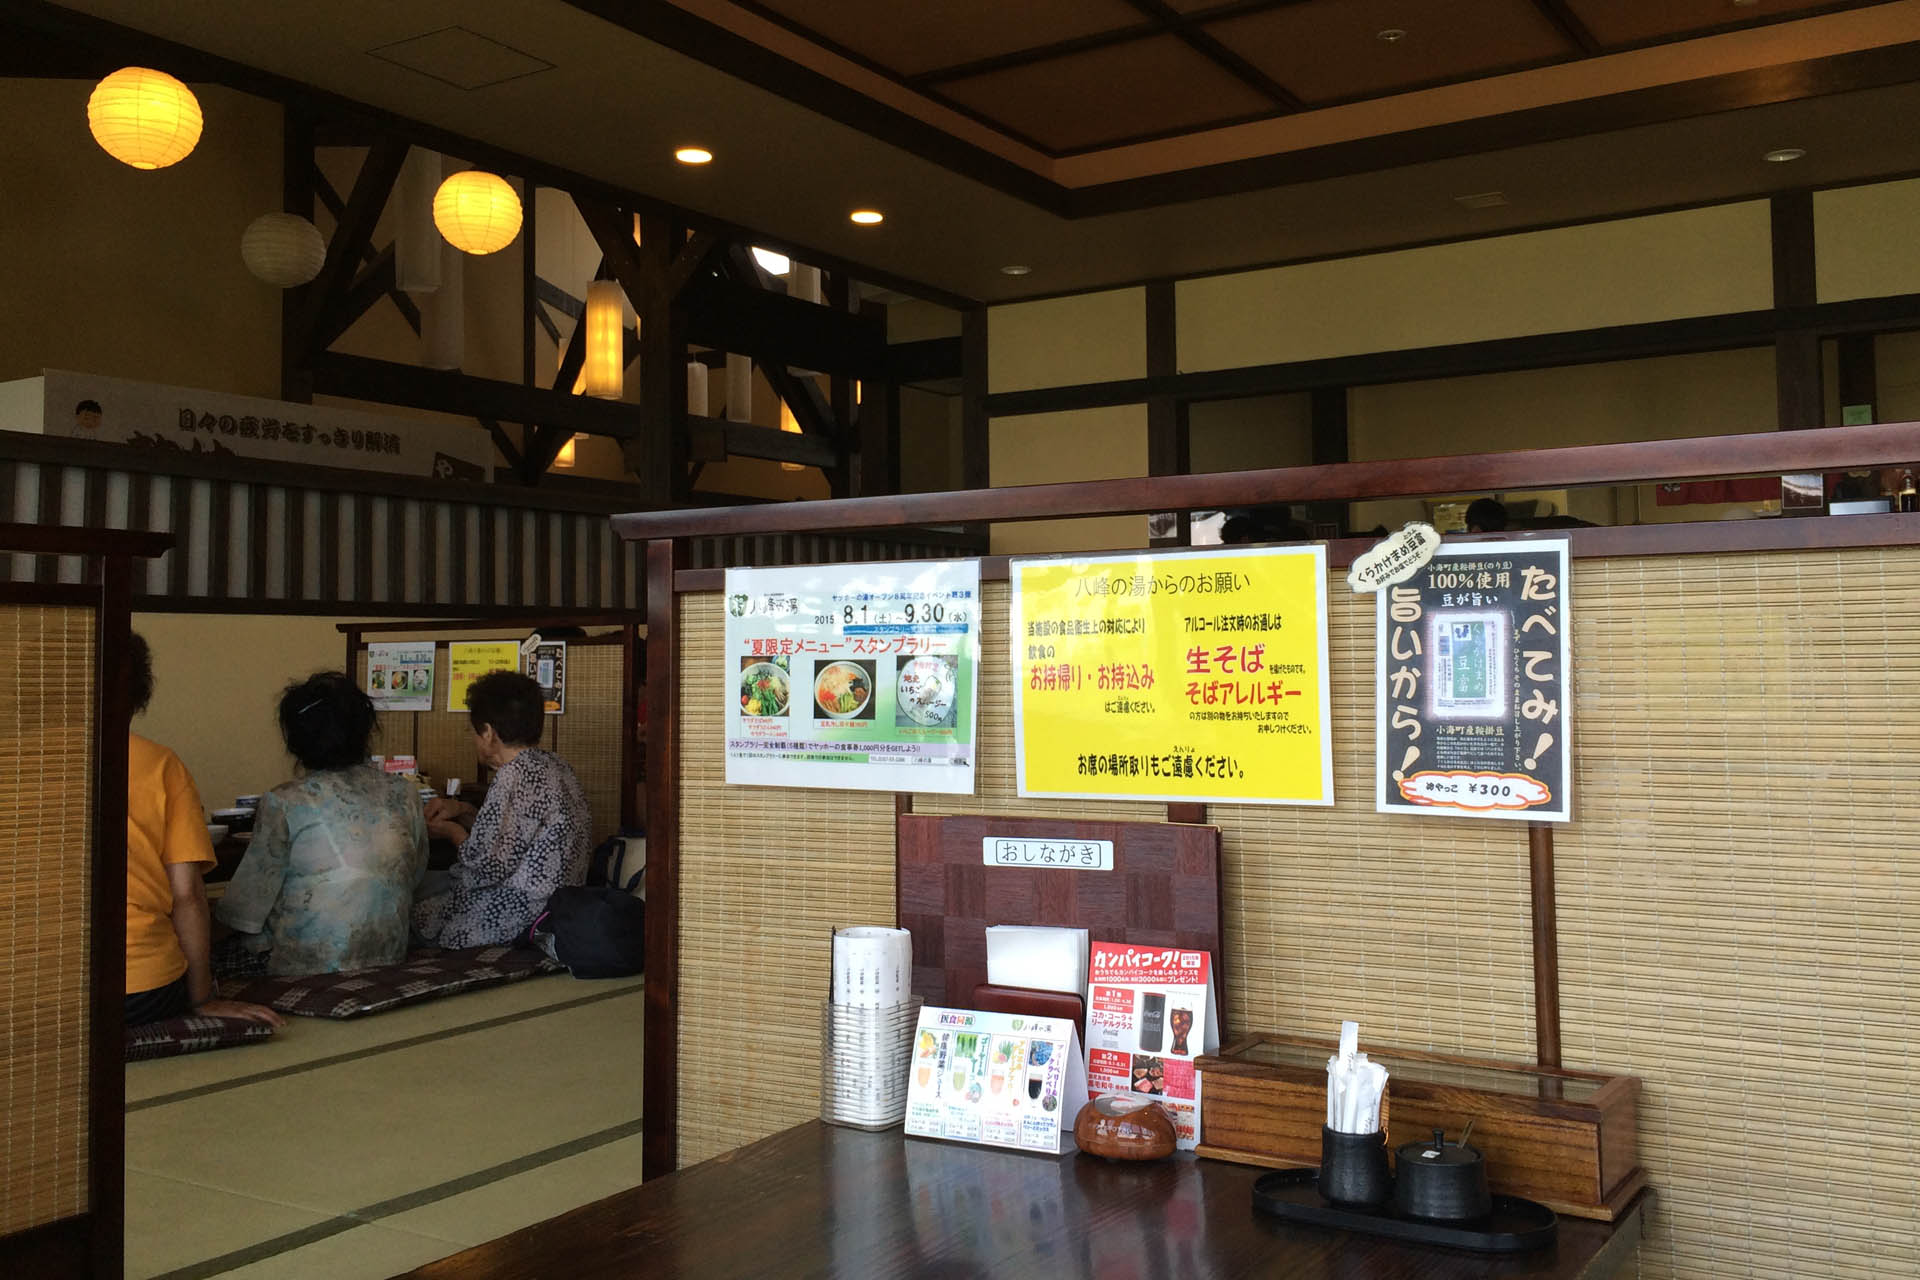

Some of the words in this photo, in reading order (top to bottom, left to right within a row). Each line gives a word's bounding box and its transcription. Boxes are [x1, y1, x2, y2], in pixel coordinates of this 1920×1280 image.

[1075, 571, 1251, 598] 八峰の湯からのお願い
[1427, 572, 1512, 590] 100%使用
[1441, 592, 1499, 608] 豆が旨い
[814, 615, 835, 625] 2015
[1028, 617, 1146, 637] 当施設の食品衛生上の対応により
[1184, 613, 1283, 632] アルコール注文時のお通しは
[1028, 644, 1056, 660] 飲食の
[1186, 643, 1266, 674] 生そば
[1029, 663, 1156, 692] お持帰り・お持込み
[1520, 565, 1558, 770] たべてみ！
[1185, 681, 1302, 706] そばアレルギー
[1390, 585, 1423, 782] 旨いから！
[1104, 700, 1156, 714] はご遠慮ください。
[1257, 724, 1313, 735] お申しつけください。
[1077, 753, 1245, 779] お席の場所取りもご遠慮ください。
[1425, 782, 1459, 793] 冷やっこ
[1468, 783, 1511, 797] ¥300
[1001, 842, 1094, 865] おしながき
[1094, 949, 1180, 969] カンパイコーク!
